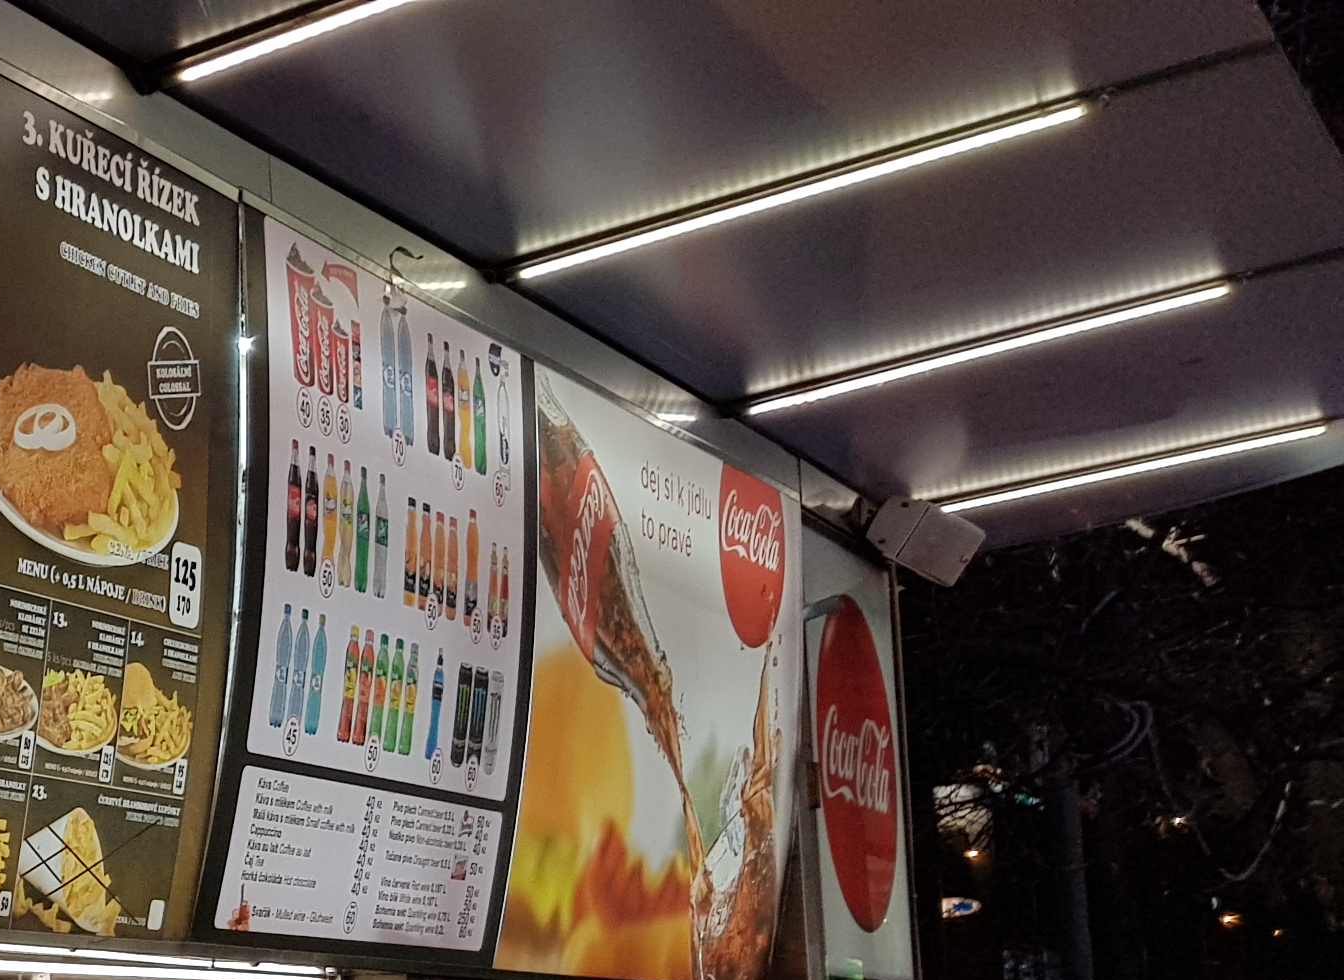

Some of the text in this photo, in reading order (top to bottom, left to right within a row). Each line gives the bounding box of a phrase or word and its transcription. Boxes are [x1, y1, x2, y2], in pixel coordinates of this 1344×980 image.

[22, 111, 201, 227] 3. KUŘECÍ ŘÍZEK
[35, 166, 201, 275] S HRANOLKAMI
[59, 241, 107, 280] CHICKEN
[299, 401, 311, 420] 40
[320, 409, 331, 427] 35
[338, 415, 349, 433] 30
[641, 460, 712, 522] dej si k jídlu
[641, 512, 693, 559] to pravé
[721, 489, 779, 571] Coca-Cola
[17, 557, 126, 601] MENU 0,5 NÁPOJE
[174, 555, 197, 592] 125
[176, 593, 191, 616] 170
[285, 730, 297, 746] 45
[822, 704, 890, 814] Coca-Cola
